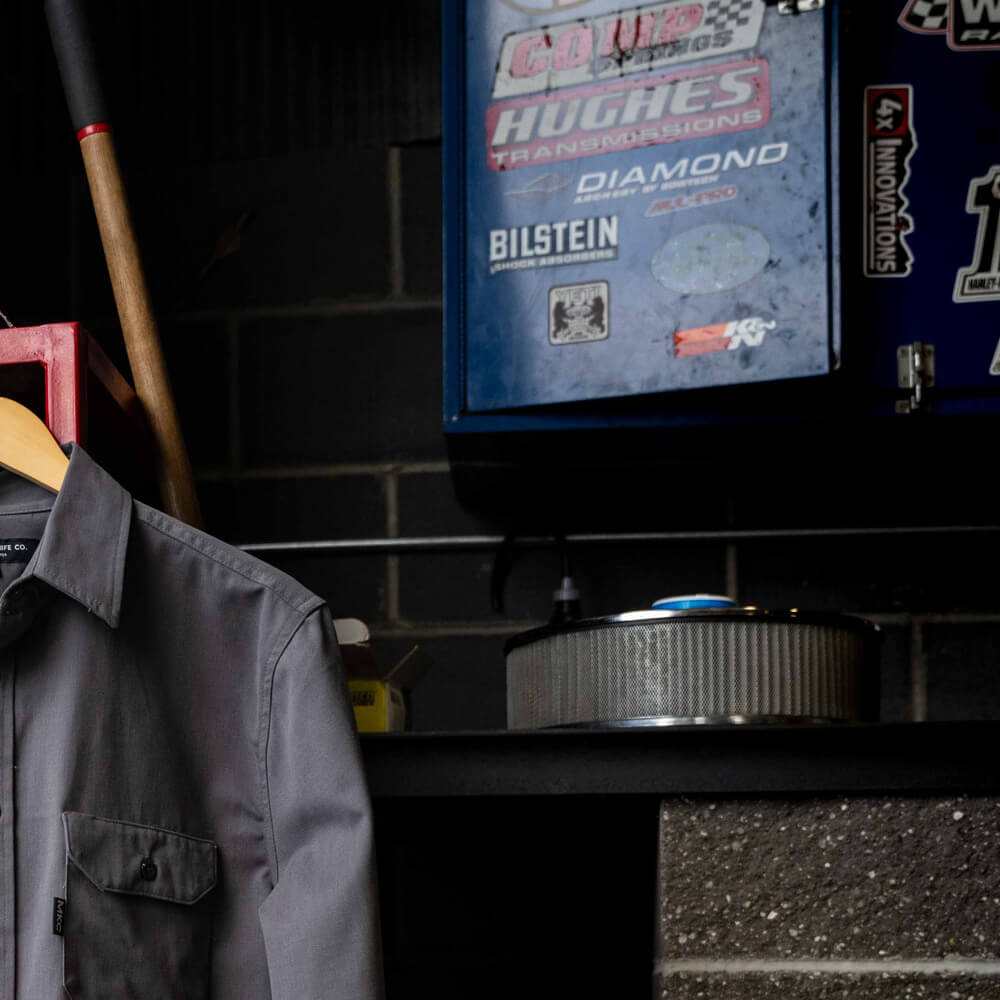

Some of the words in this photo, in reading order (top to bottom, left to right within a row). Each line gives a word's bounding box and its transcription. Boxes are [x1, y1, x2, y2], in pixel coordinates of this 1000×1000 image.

[508, 5, 704, 79] COMP
[491, 67, 760, 146] HUGHES
[491, 109, 763, 165] TRANSMISSIONS
[576, 141, 789, 194] DIAMOND
[876, 138, 903, 272] INNOVATIONS
[489, 214, 618, 262] BILSTEIN
[492, 258, 536, 273] SHOCK
[539, 249, 616, 266] ABSORBERS
[14, 543, 28, 551] CO.
